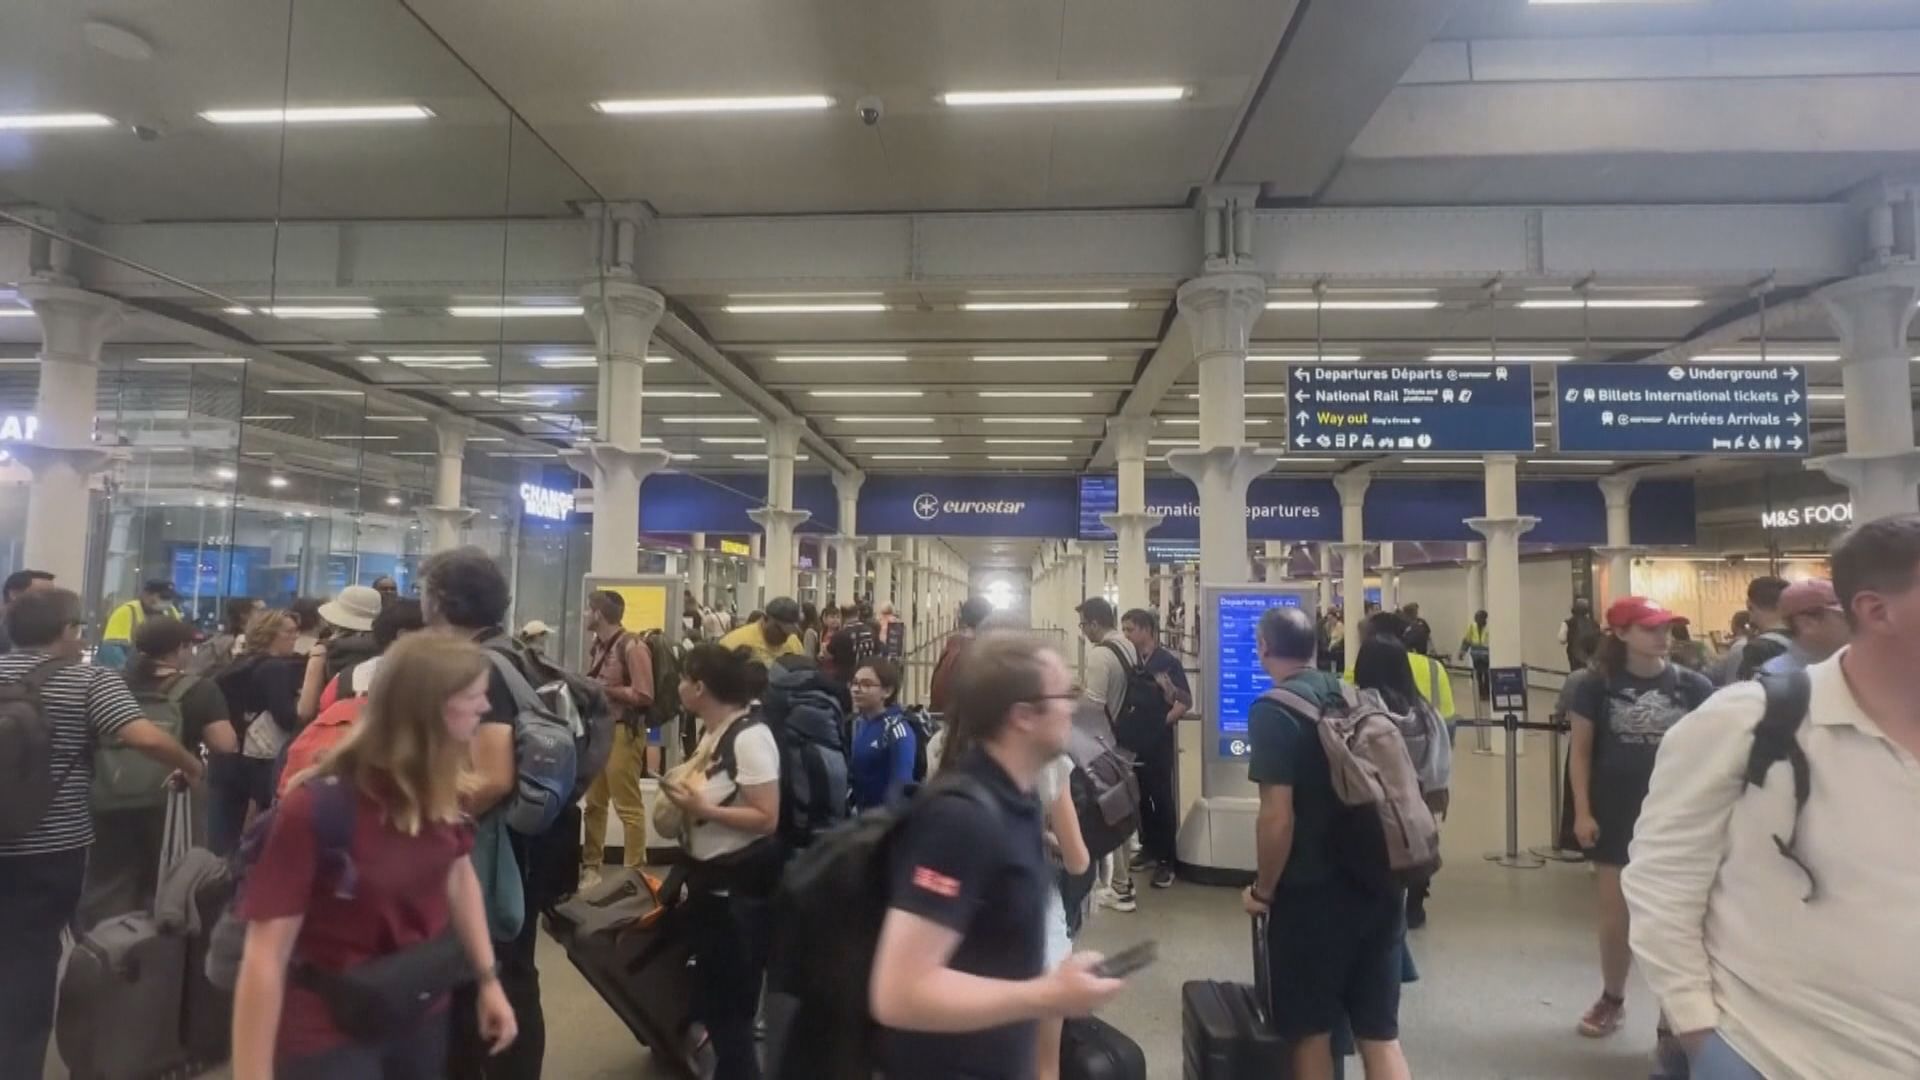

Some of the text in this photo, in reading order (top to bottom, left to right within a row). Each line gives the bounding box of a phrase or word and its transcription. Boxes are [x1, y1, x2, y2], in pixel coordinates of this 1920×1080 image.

[1315, 367, 1389, 382] Departures
[1391, 366, 1443, 382] Départs
[1688, 367, 1778, 383] Underground
[1315, 389, 1399, 402] National Rail
[1598, 389, 1779, 402] Billets International tickets
[1317, 412, 1368, 427] Way out
[1667, 411, 1724, 426] Arrivées
[1727, 411, 1781, 426] Arrivals
[943, 500, 1025, 515] eurostar
[1246, 502, 1320, 520] epartures
[1761, 508, 1800, 529] M&S
